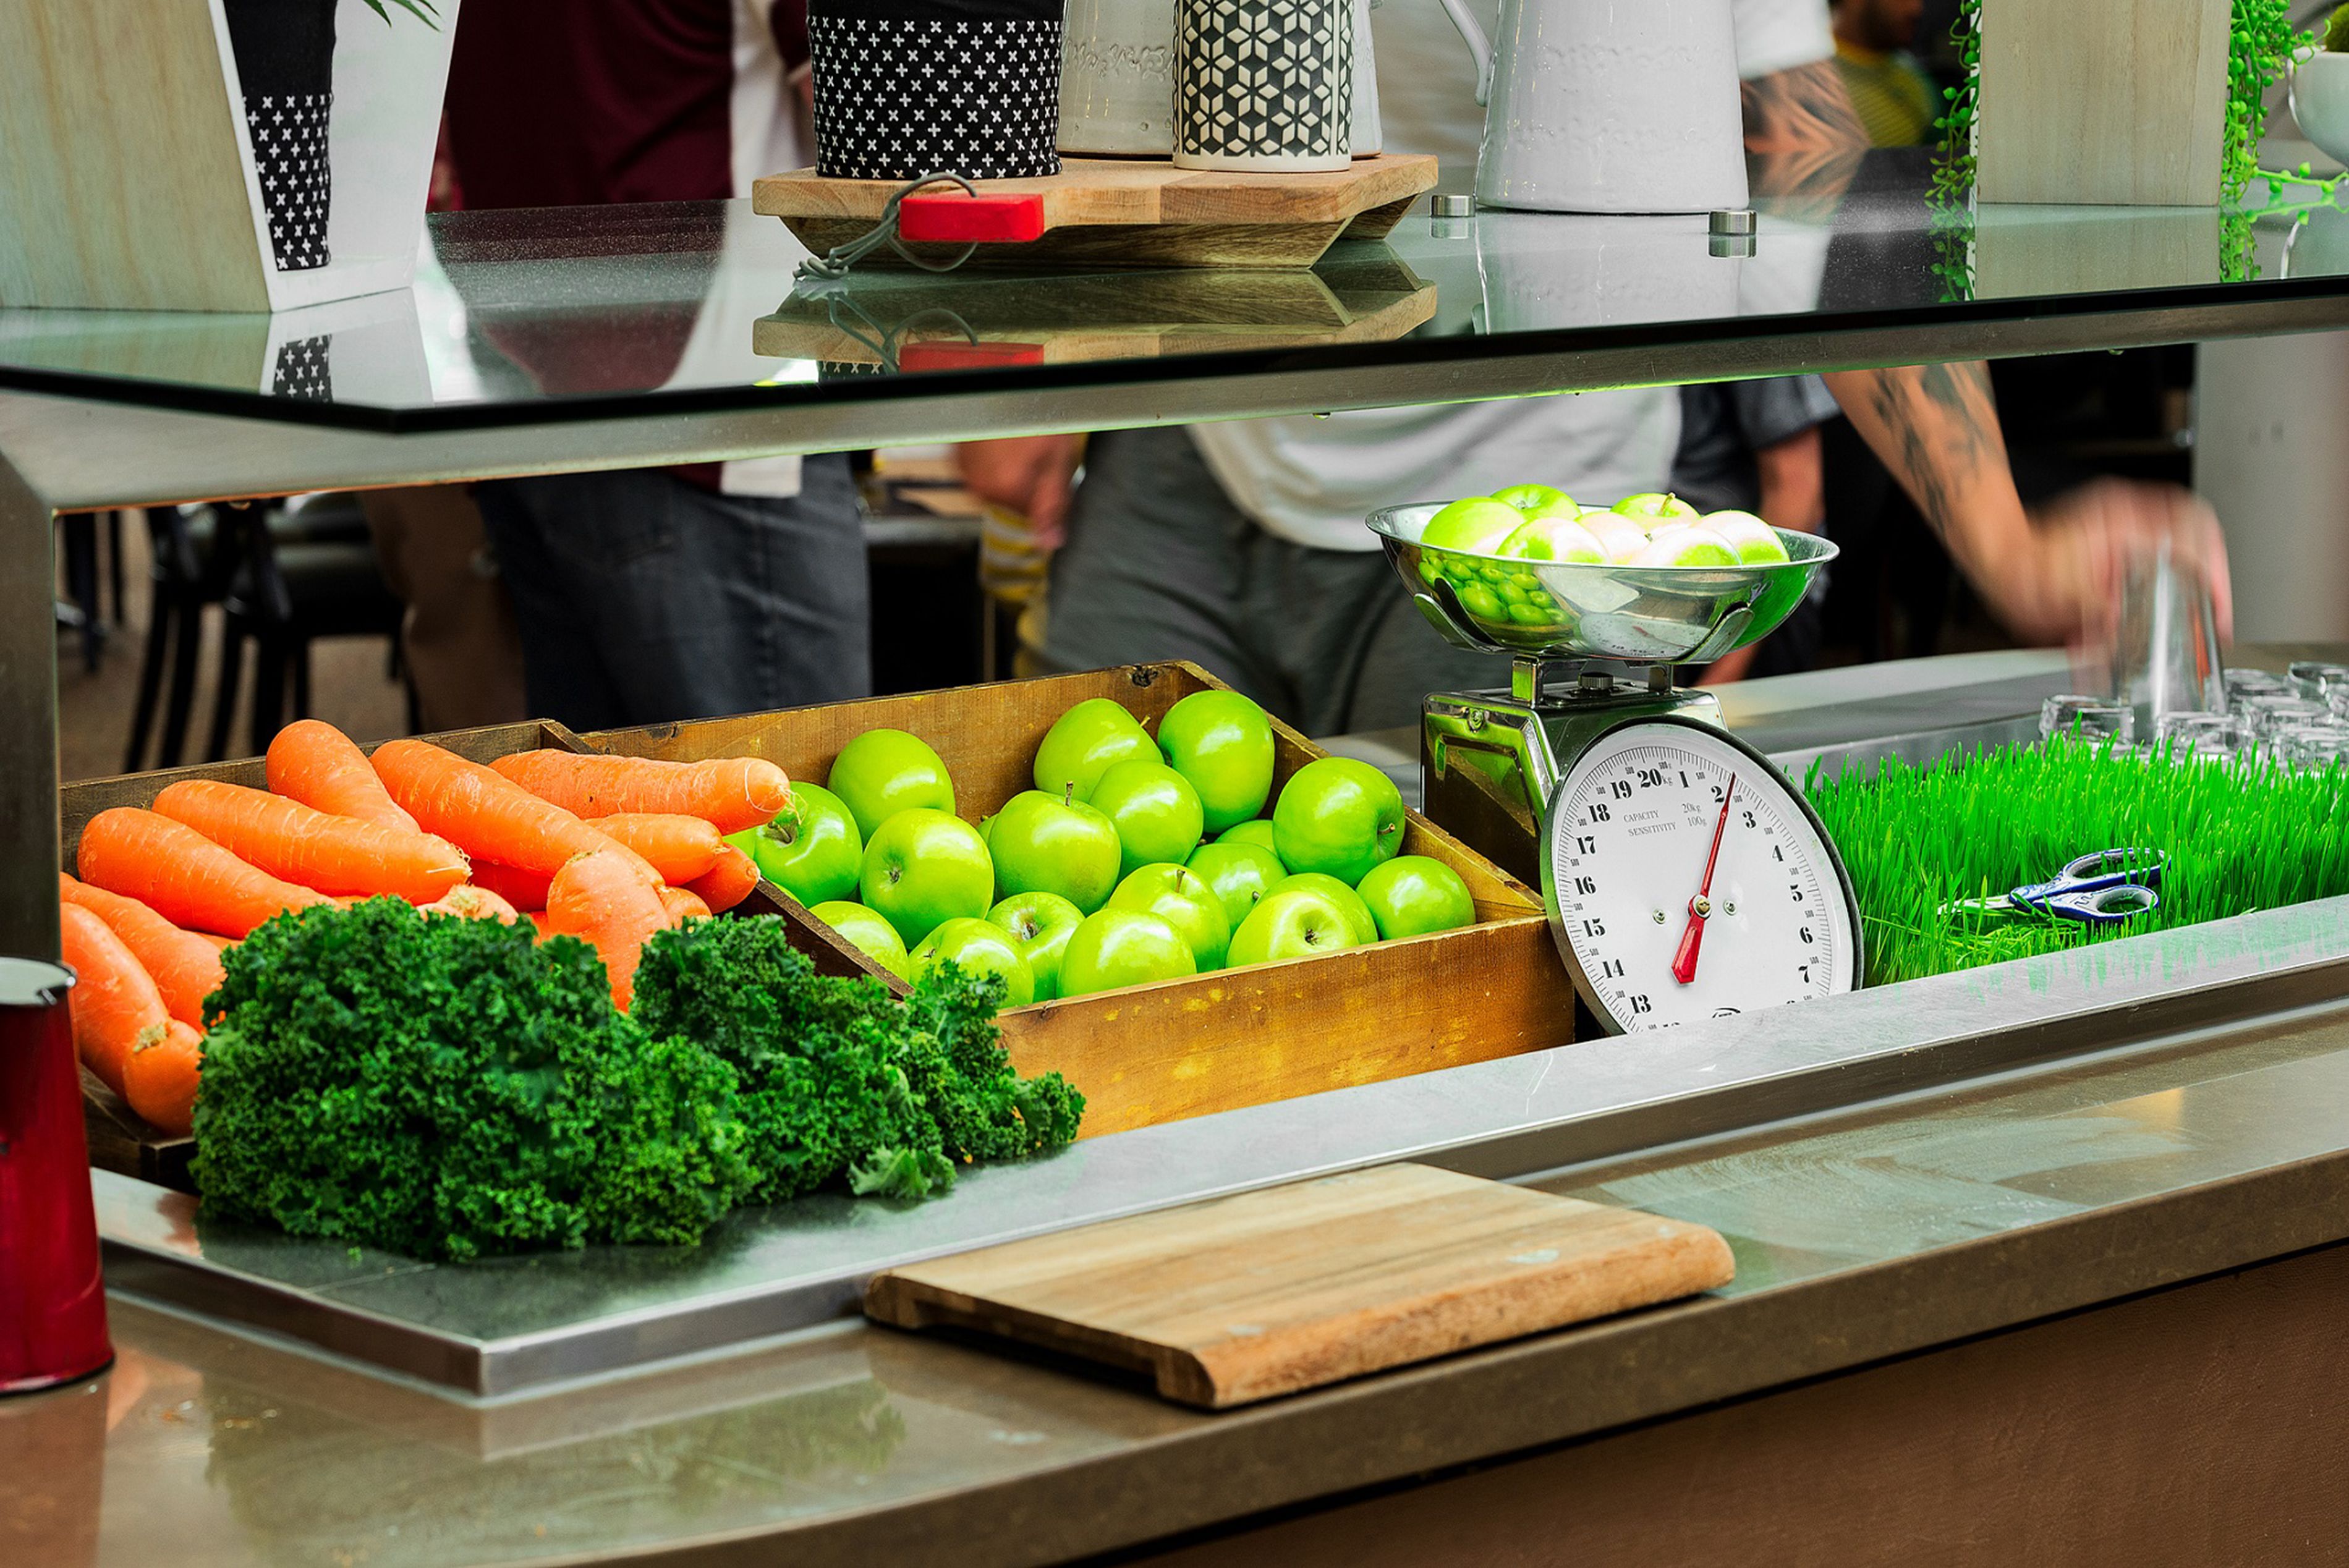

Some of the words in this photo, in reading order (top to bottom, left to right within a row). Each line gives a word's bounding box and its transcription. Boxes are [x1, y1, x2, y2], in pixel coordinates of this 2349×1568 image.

[1679, 771, 1689, 788] 1
[1610, 780, 1632, 799] 19
[1711, 786, 1725, 803] 2
[1588, 803, 1610, 823] 18
[1623, 810, 1659, 823] CAPACITY
[1682, 803, 1701, 813] 20kg
[1743, 811, 1756, 828] 3
[1628, 822, 1676, 836] SENSITIVITY
[1576, 836, 1595, 854] 17
[1772, 845, 1783, 862] 4
[1574, 876, 1596, 895] 16
[1790, 884, 1803, 902] 5
[1582, 918, 1605, 937] 15
[1799, 926, 1813, 944] 6
[1602, 959, 1625, 978] 14
[1798, 965, 1809, 983] 7
[1630, 994, 1651, 1014] 13
